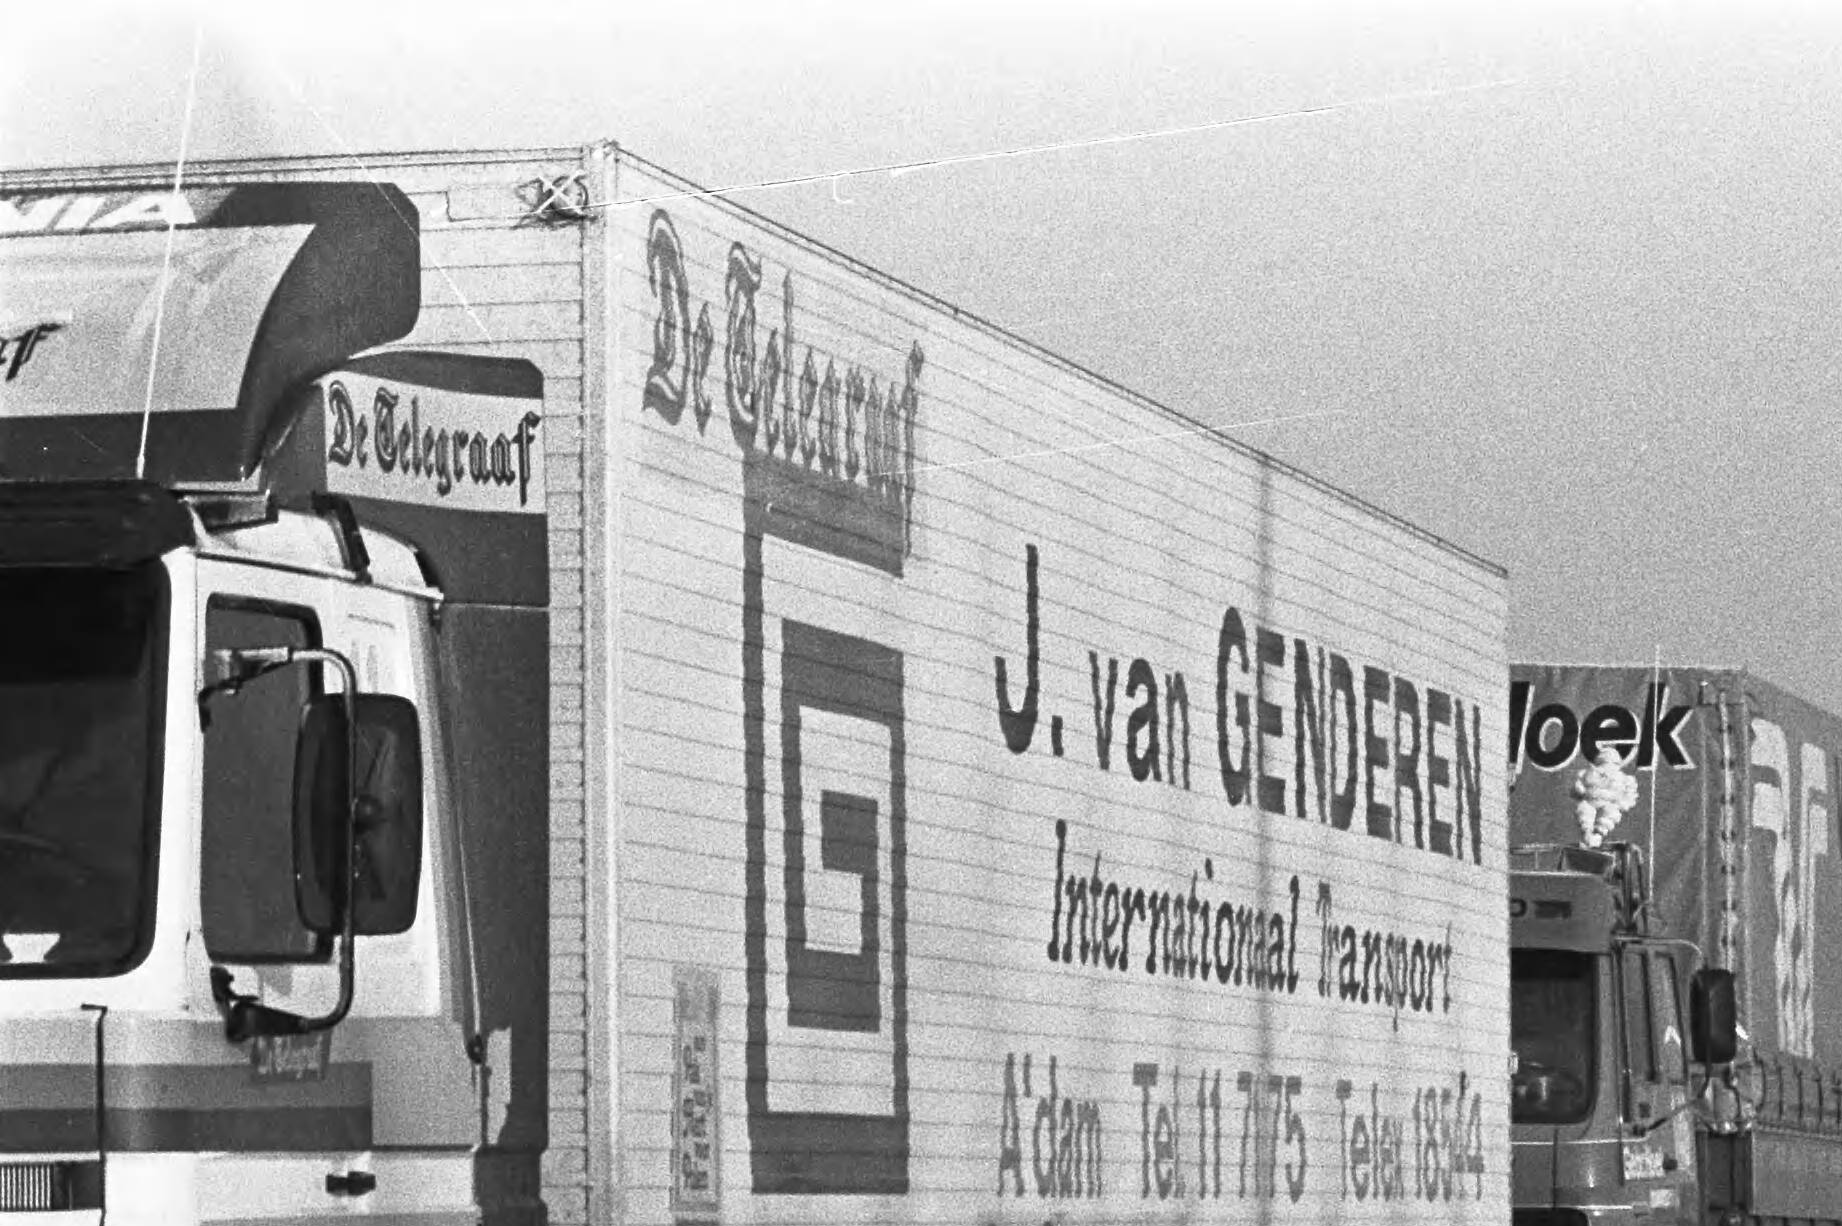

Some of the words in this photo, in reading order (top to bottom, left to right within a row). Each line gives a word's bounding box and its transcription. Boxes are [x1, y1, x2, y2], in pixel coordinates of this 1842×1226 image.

[328, 379, 368, 469] De
[373, 387, 542, 507] Telegraaf
[642, 208, 714, 436] De
[725, 241, 924, 558] Telegraaf
[995, 543, 1064, 758] J.
[1088, 650, 1191, 791] van
[1215, 606, 1483, 866] GENDEREN
[1047, 818, 1300, 995] Internationaal
[1316, 880, 1453, 1033] Transport
